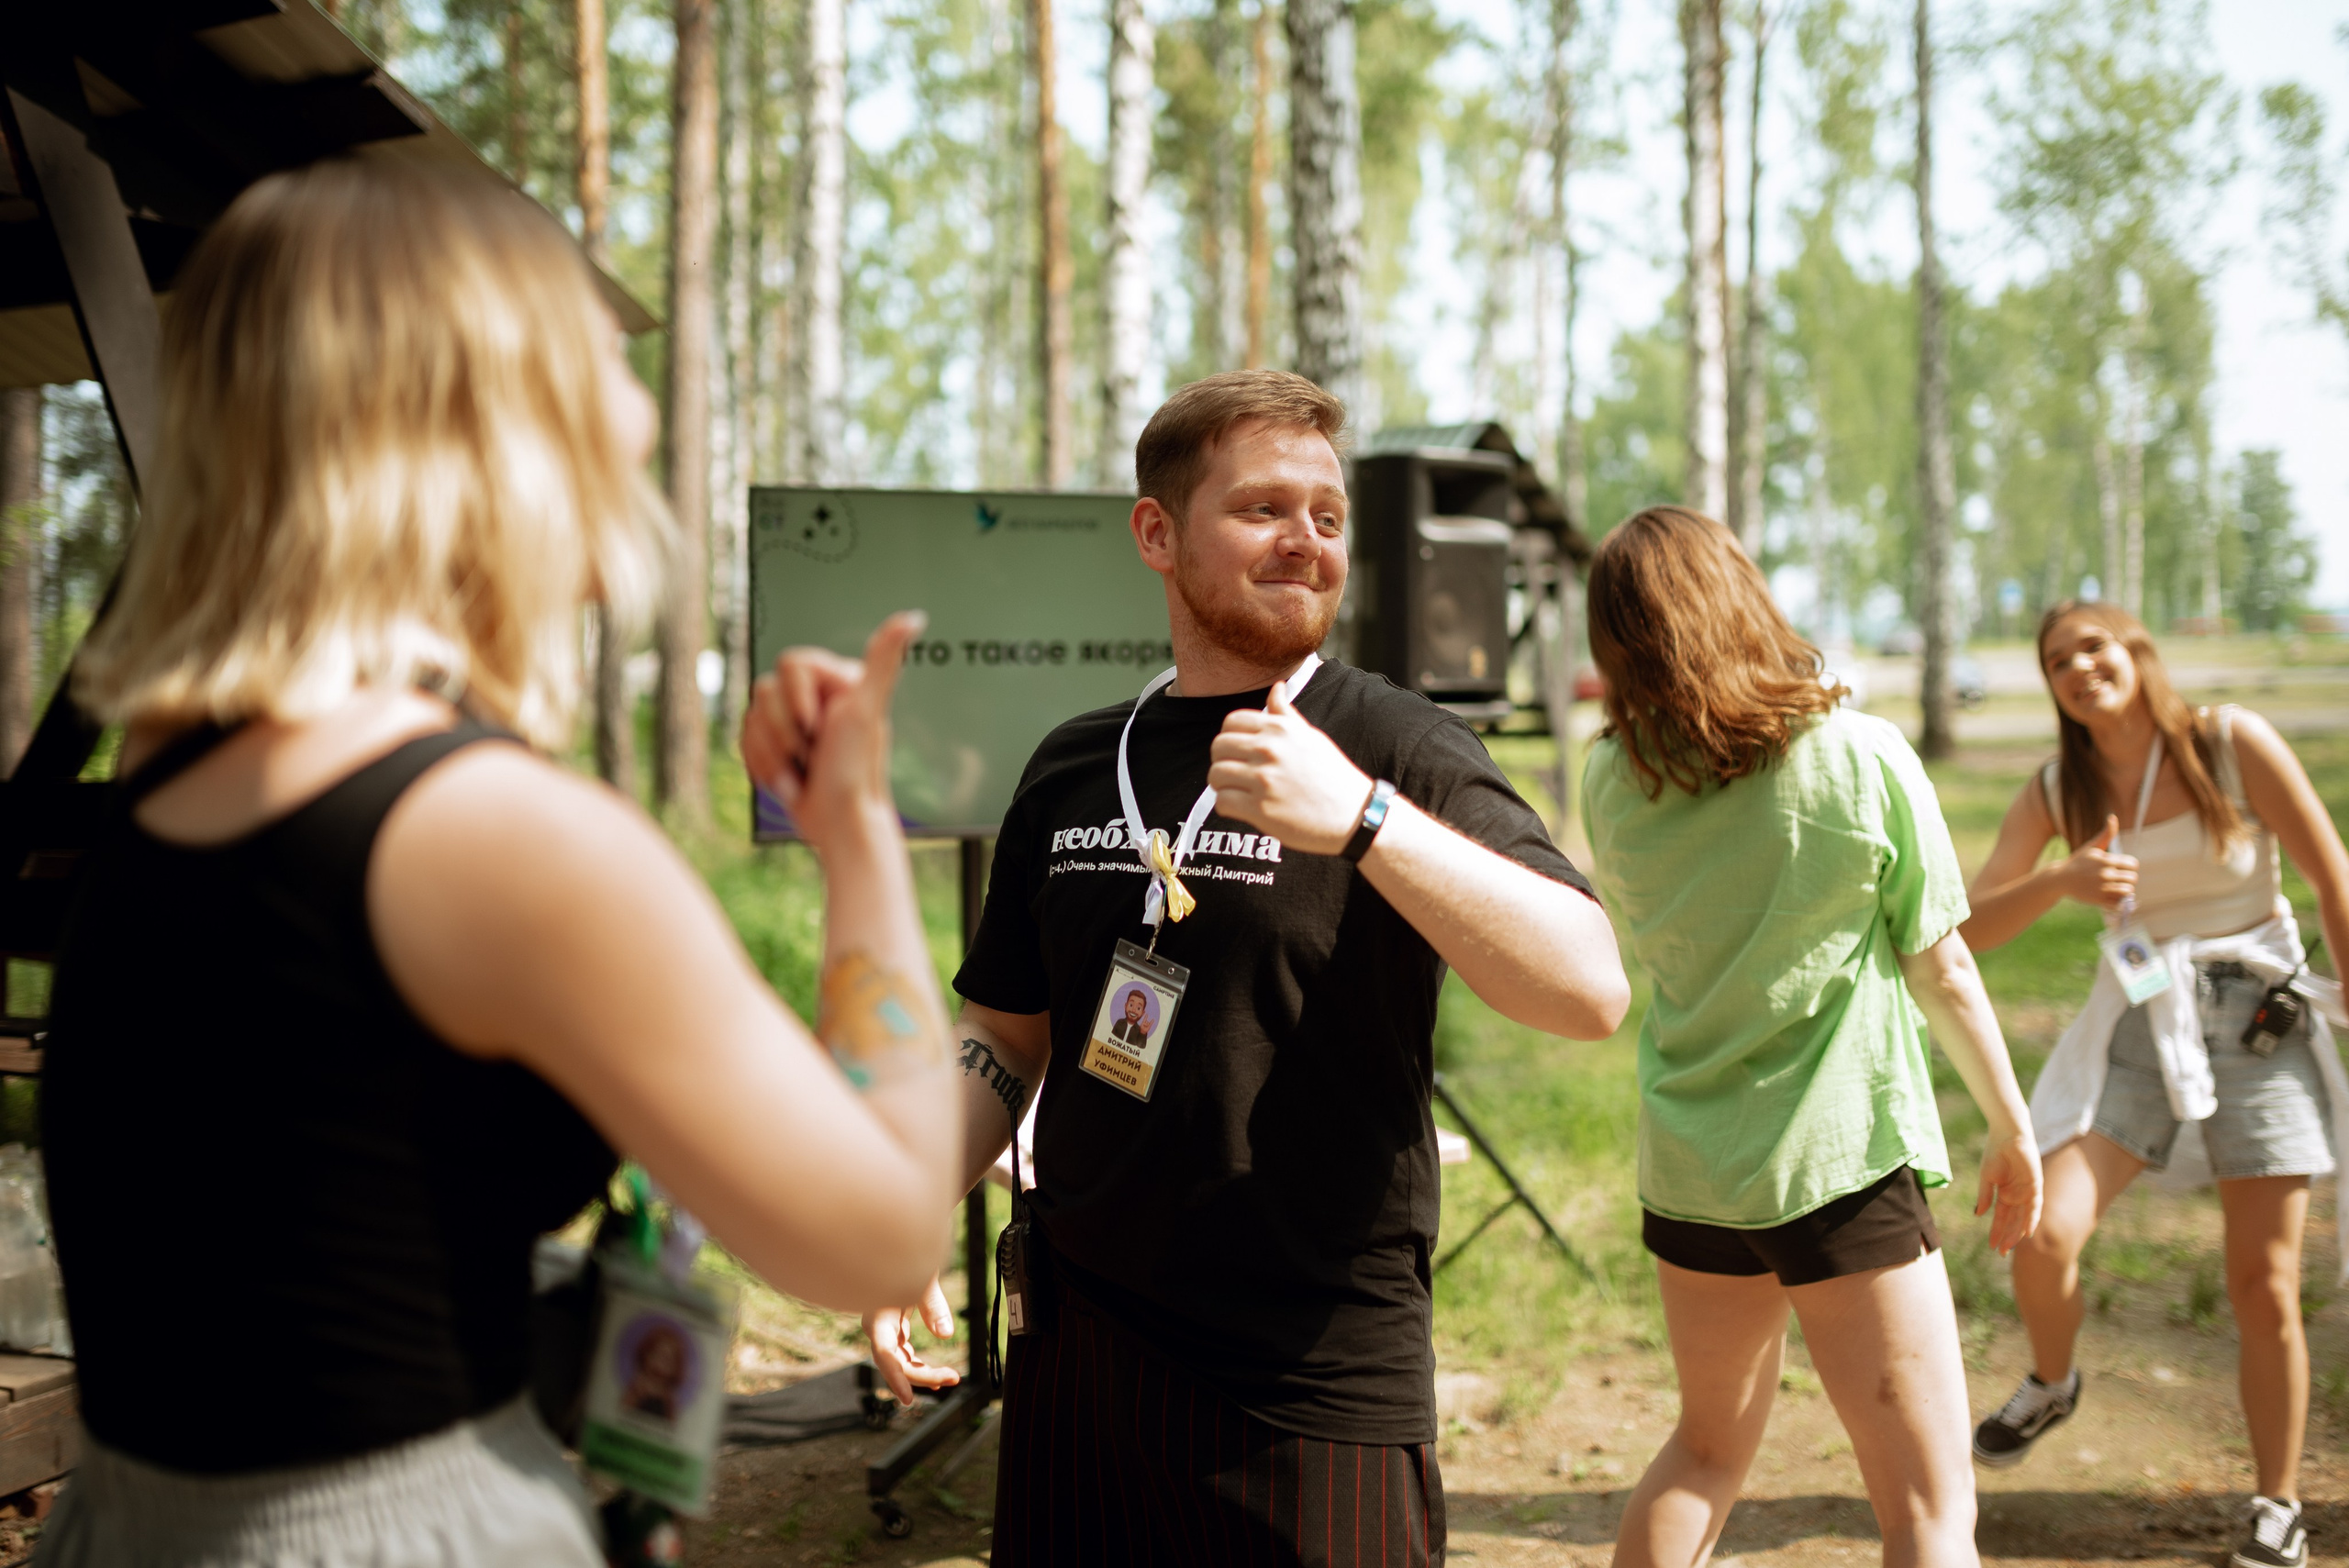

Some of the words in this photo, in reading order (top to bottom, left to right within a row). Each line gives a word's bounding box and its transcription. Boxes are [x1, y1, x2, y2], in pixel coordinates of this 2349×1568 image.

[902, 639, 950, 665] то
[957, 639, 1066, 665] такое
[1067, 860, 1096, 872] Очень
[1097, 862, 1152, 874] значимы
[1212, 865, 1275, 886] Дмитрий
[1097, 1046, 1142, 1073] ДМИТРИЙ
[1107, 1037, 1141, 1058] ВОЖАТЫЙ
[1094, 1059, 1137, 1086] УФИМЦЕВ
